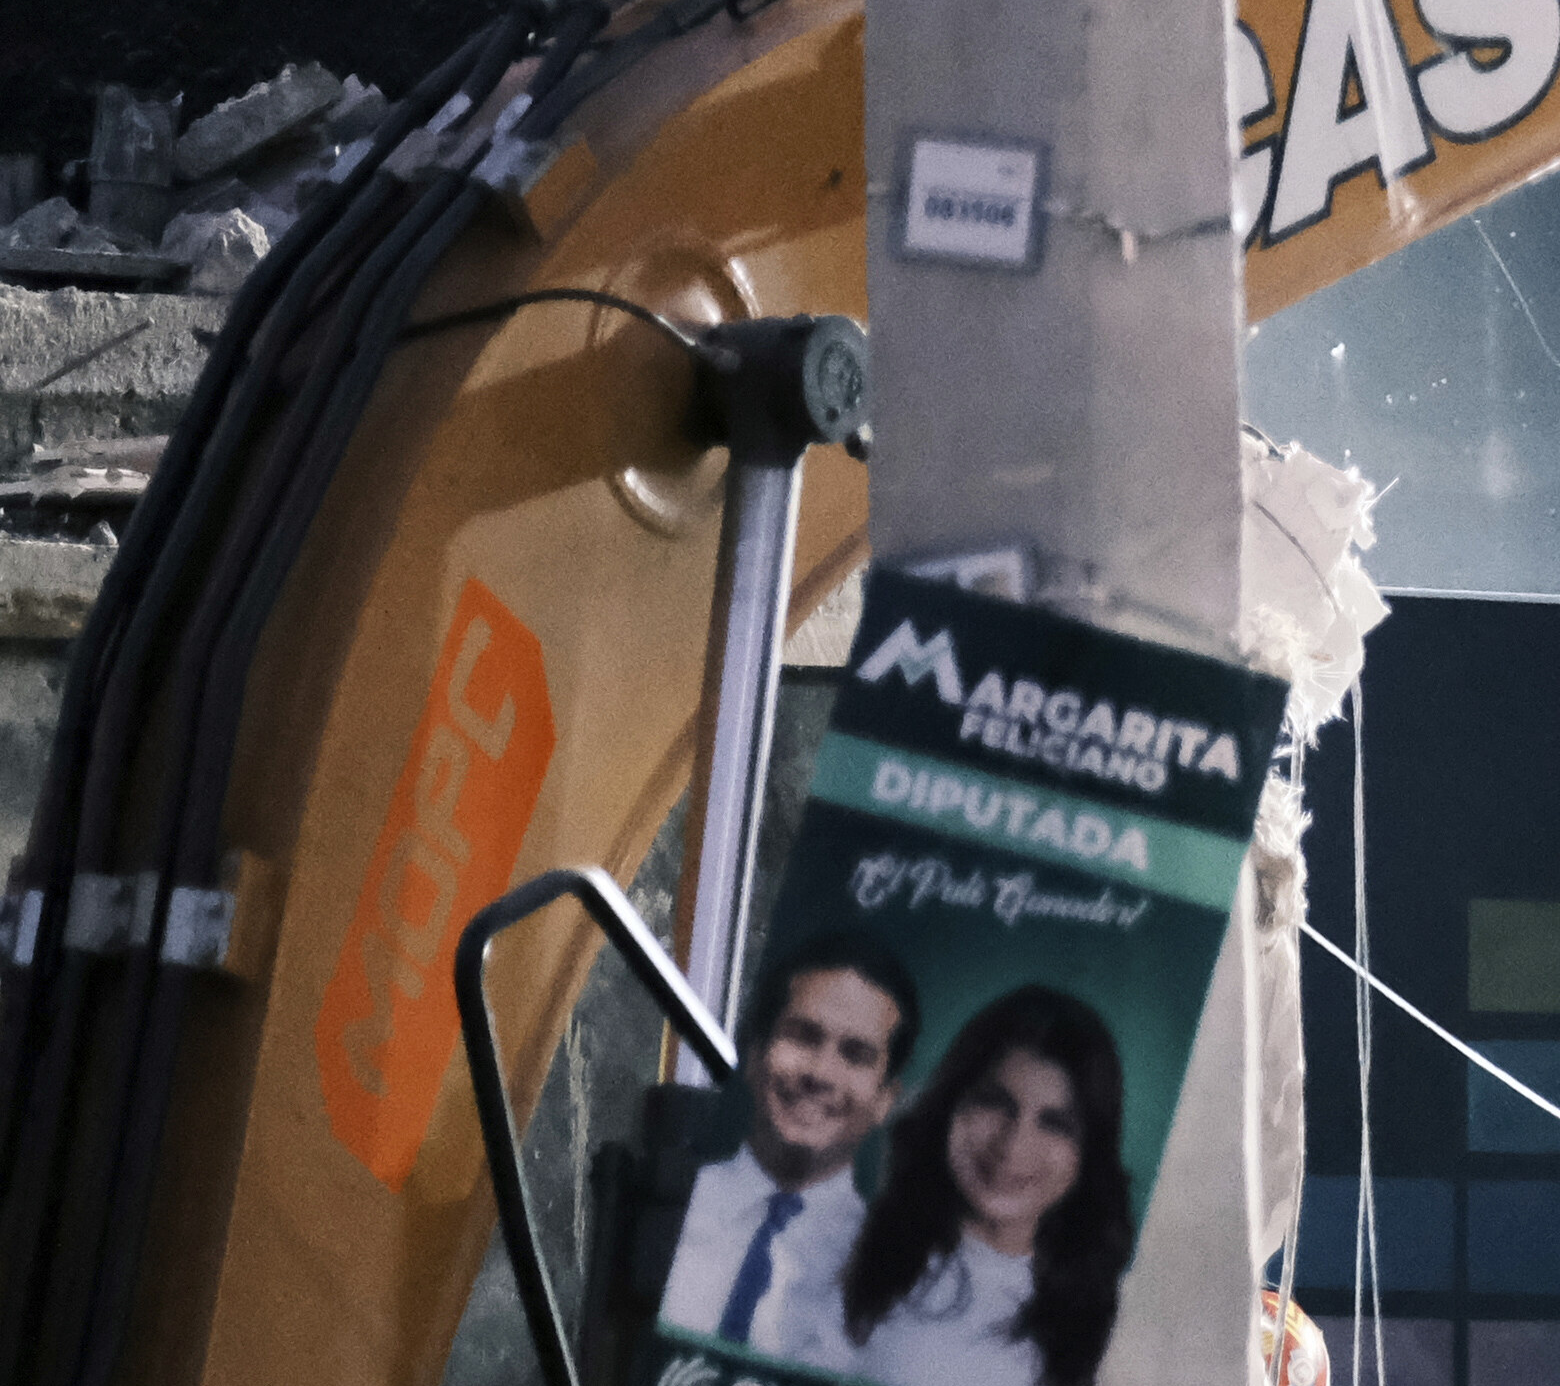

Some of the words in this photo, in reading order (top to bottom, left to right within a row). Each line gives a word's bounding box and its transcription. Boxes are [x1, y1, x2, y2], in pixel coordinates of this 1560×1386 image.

[857, 619, 1241, 781] MARGARITA
[959, 709, 1168, 793] FELICIANO
[342, 615, 516, 1098] MOPC
[872, 758, 1149, 870] DIPUTADA
